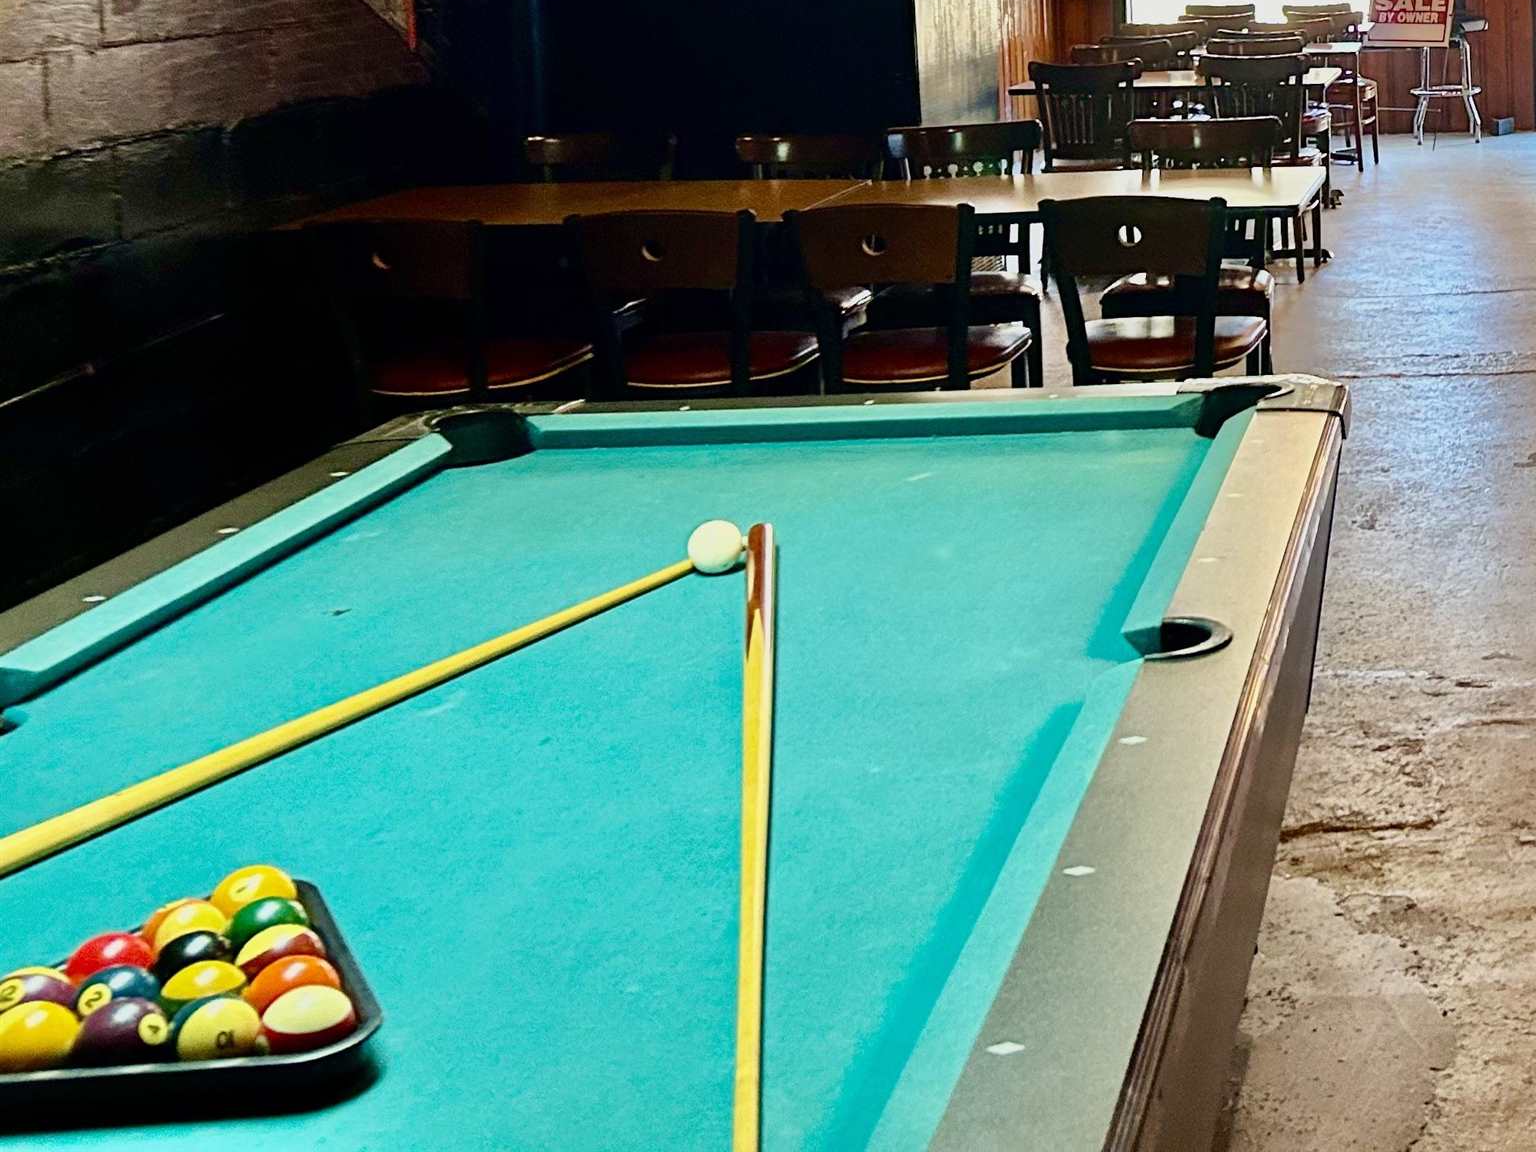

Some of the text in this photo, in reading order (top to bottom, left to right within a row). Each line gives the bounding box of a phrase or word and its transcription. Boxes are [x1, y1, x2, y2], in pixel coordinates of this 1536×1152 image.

[1378, 12, 1439, 23] BY OWNER
[84, 990, 103, 1009] 2
[147, 1023, 161, 1035] 4
